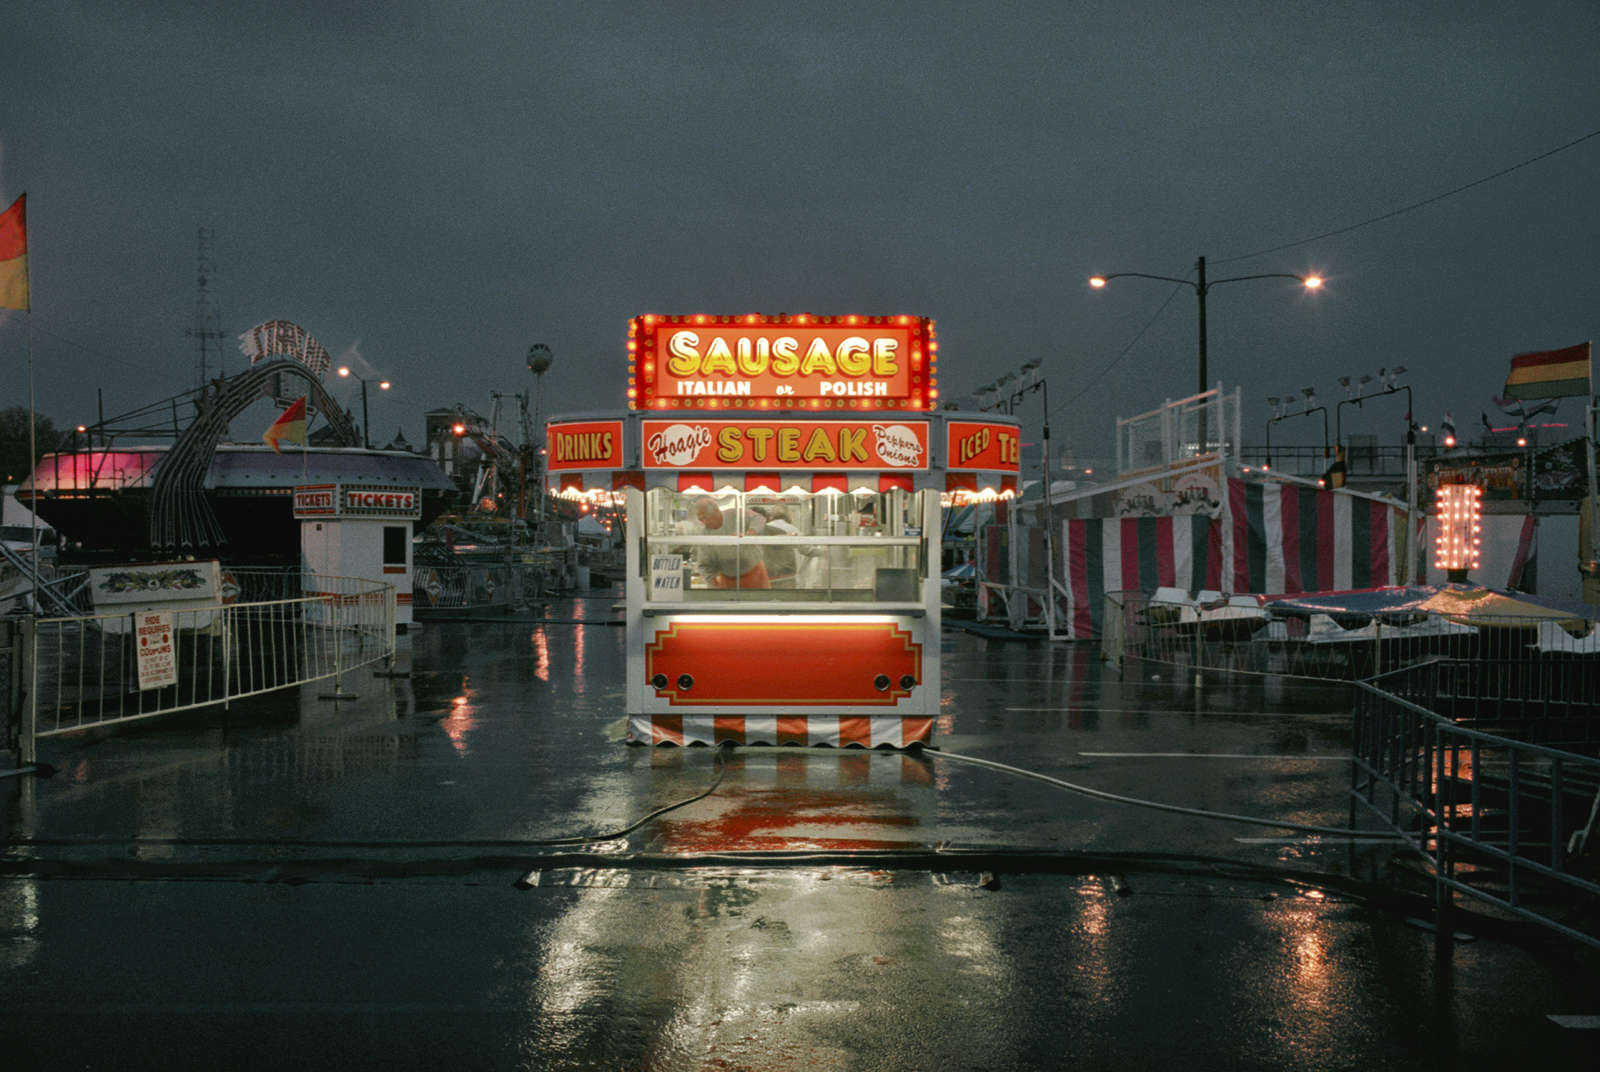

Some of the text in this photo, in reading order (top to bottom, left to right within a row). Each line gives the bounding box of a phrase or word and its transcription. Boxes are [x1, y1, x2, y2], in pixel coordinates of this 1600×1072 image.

[668, 330, 899, 376] SAUSAGE
[677, 381, 888, 396] ITALIAN or POLISH
[556, 431, 612, 462] DRINKS
[649, 427, 711, 464] Hoagie
[717, 426, 869, 463] STEAK
[874, 426, 922, 454] Peppers
[877, 442, 919, 466] Onions
[960, 427, 991, 464] ICED
[296, 493, 332, 506] TICKETS
[348, 492, 413, 508] TICKETS
[655, 576, 681, 589] WATER
